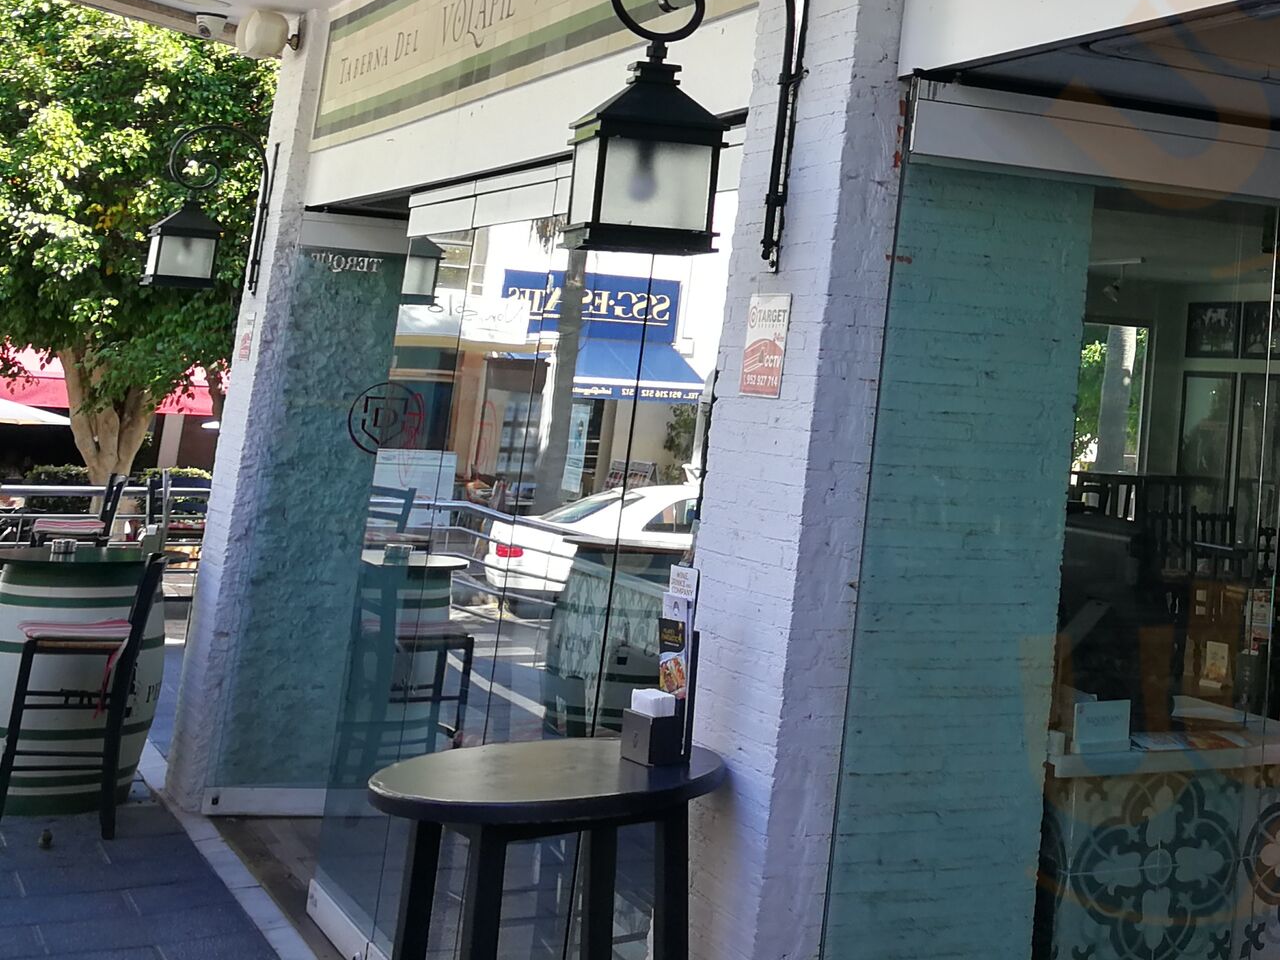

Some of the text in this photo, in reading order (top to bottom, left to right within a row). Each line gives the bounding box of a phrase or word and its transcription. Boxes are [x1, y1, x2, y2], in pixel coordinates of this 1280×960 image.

[339, 44, 389, 85] TABERNA
[394, 29, 419, 62] DEL
[757, 308, 787, 323] TARGET
